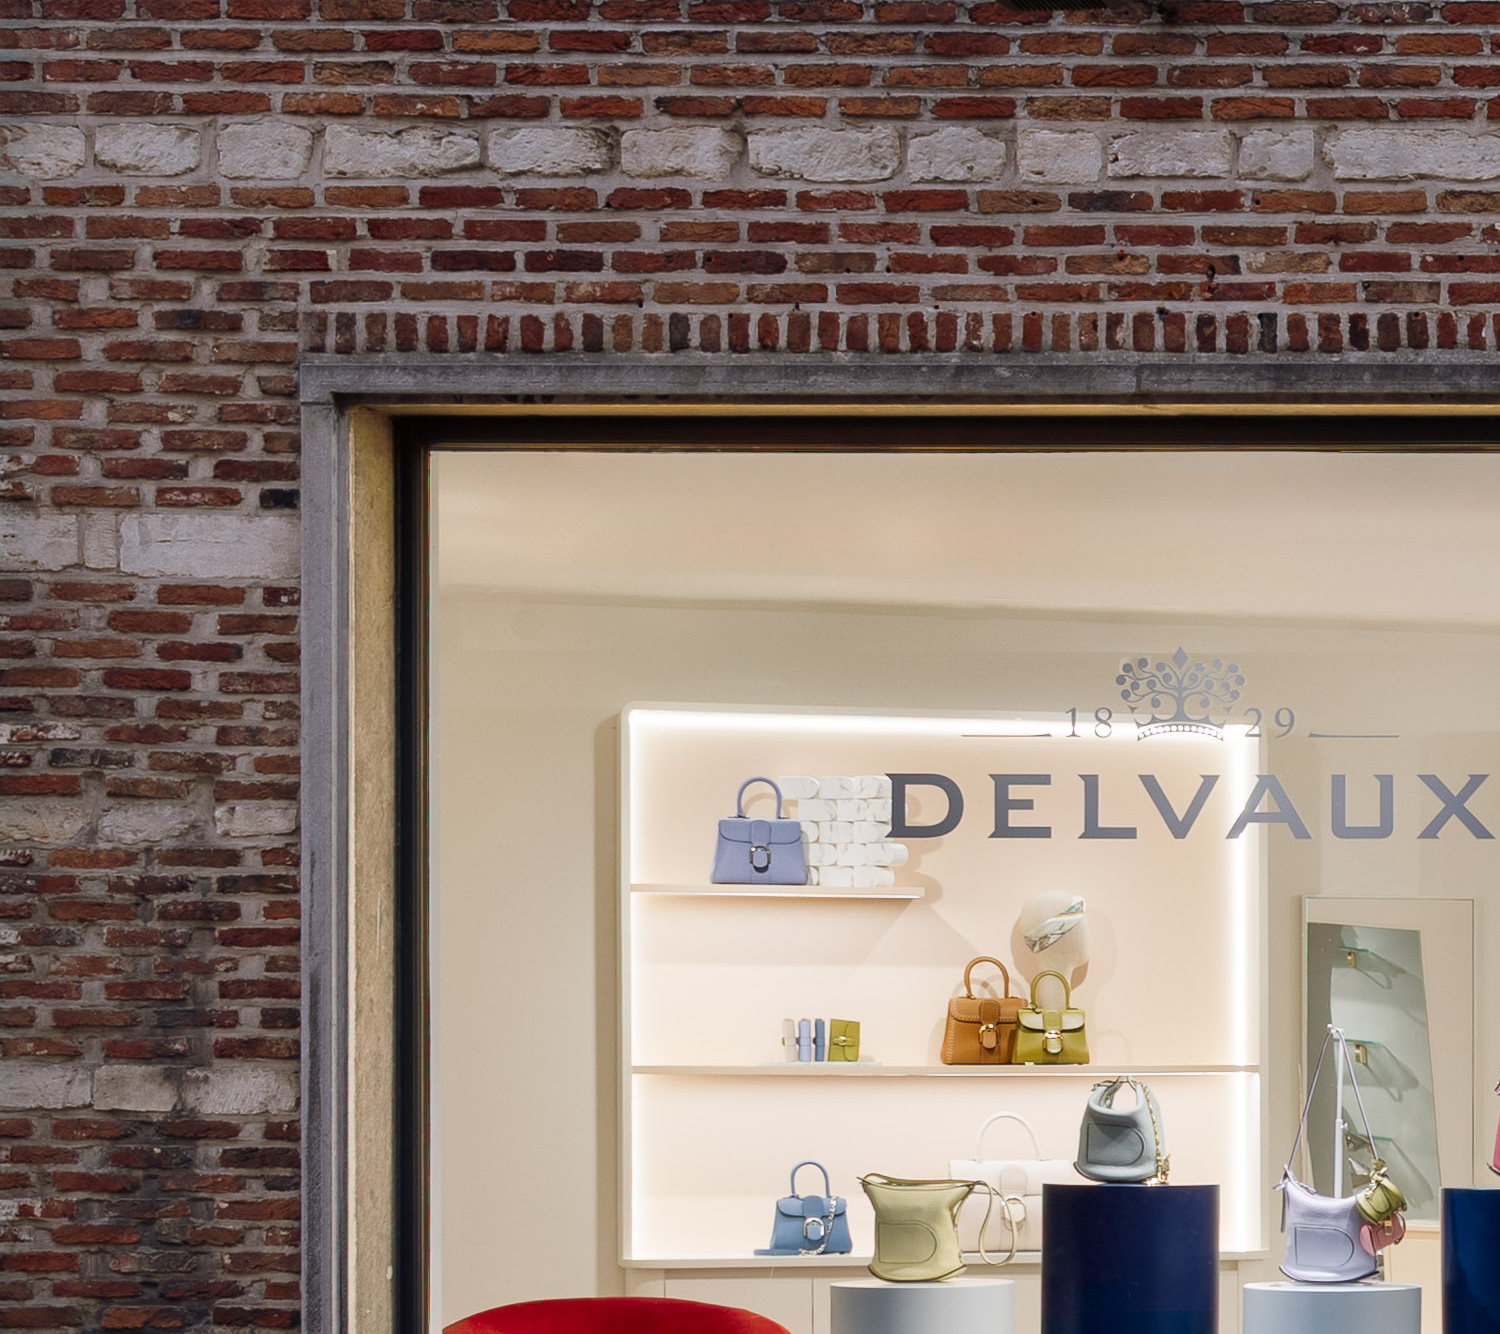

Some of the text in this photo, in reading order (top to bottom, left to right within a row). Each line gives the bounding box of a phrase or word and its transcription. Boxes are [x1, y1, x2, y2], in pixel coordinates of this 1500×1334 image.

[1064, 707, 1296, 739] 18 29
[884, 773, 1496, 840] DELVAUX
